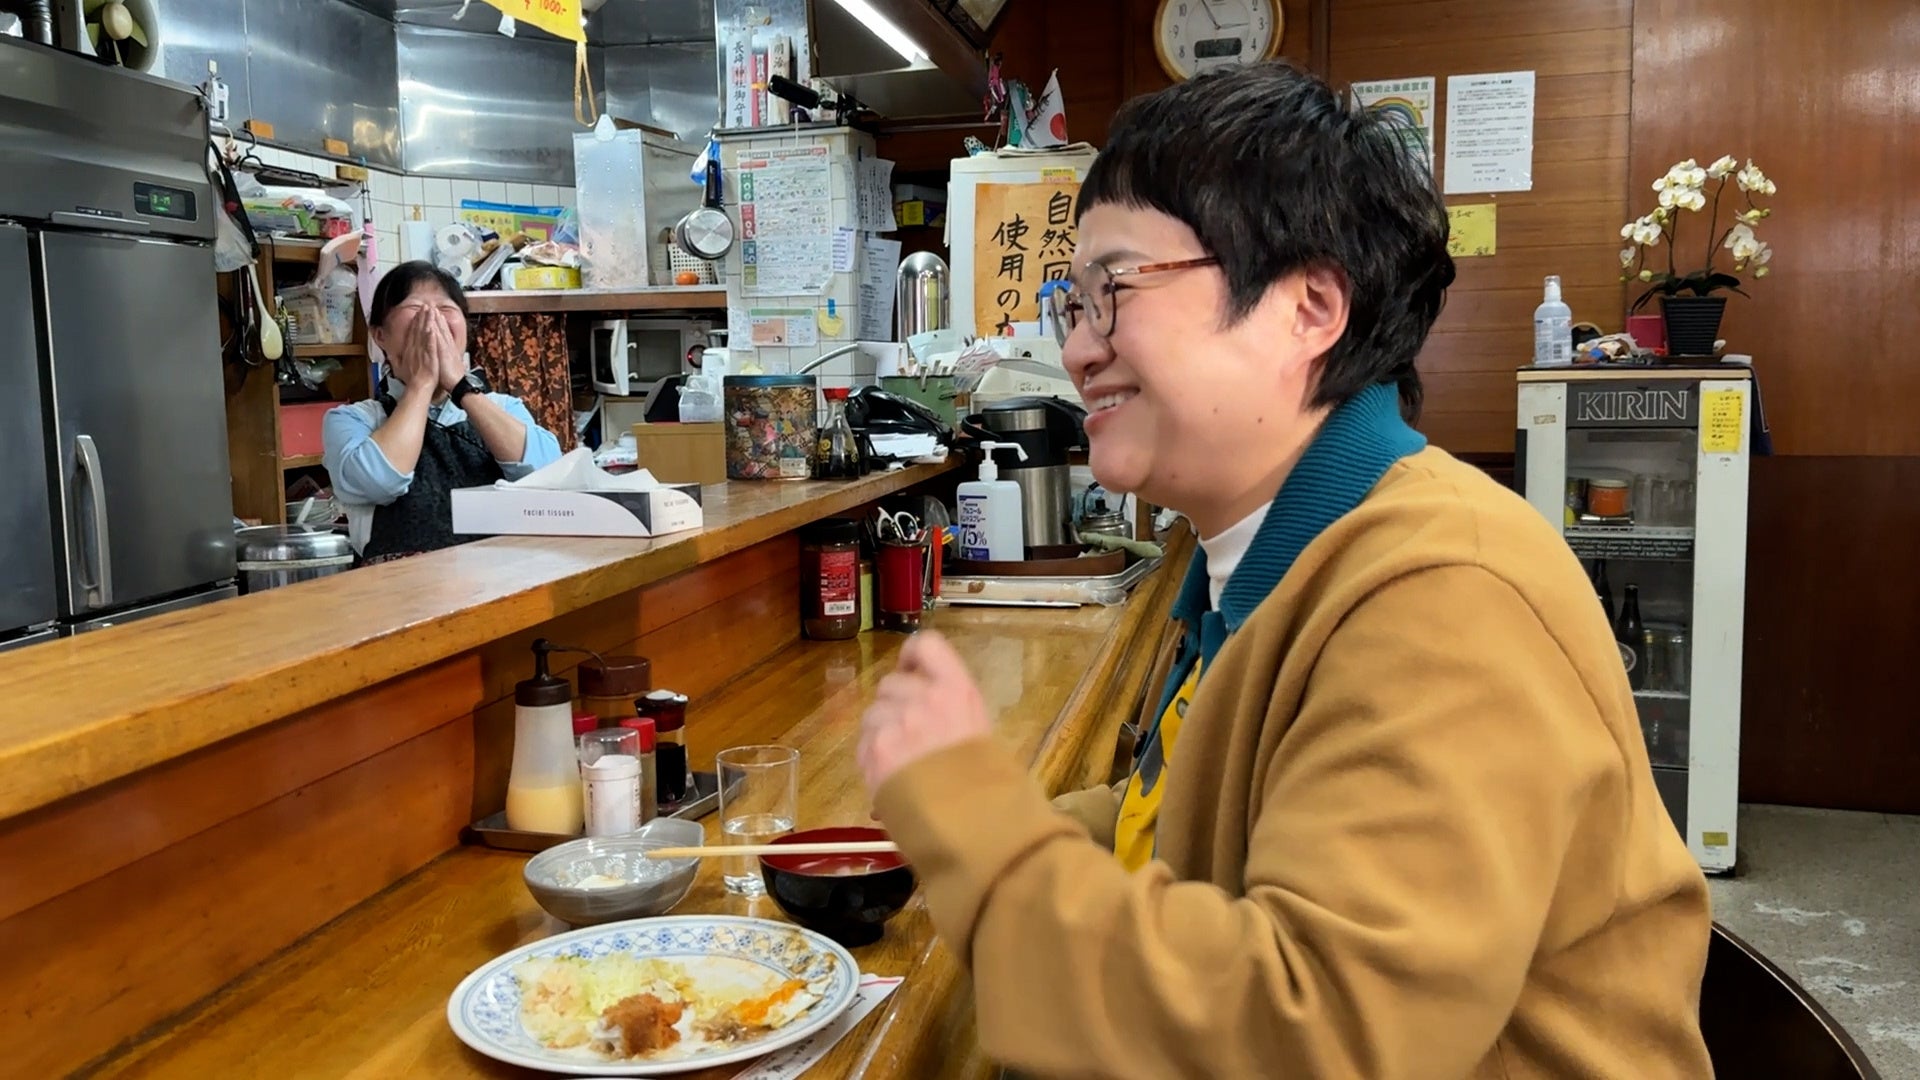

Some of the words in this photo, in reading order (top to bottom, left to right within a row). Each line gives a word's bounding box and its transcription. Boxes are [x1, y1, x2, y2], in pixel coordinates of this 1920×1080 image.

[1038, 190, 1077, 318] 自然回
[1577, 391, 1688, 421] KIRIN
[523, 508, 545, 517] facial
[548, 508, 575, 517] tissues
[961, 524, 988, 546] 75%
